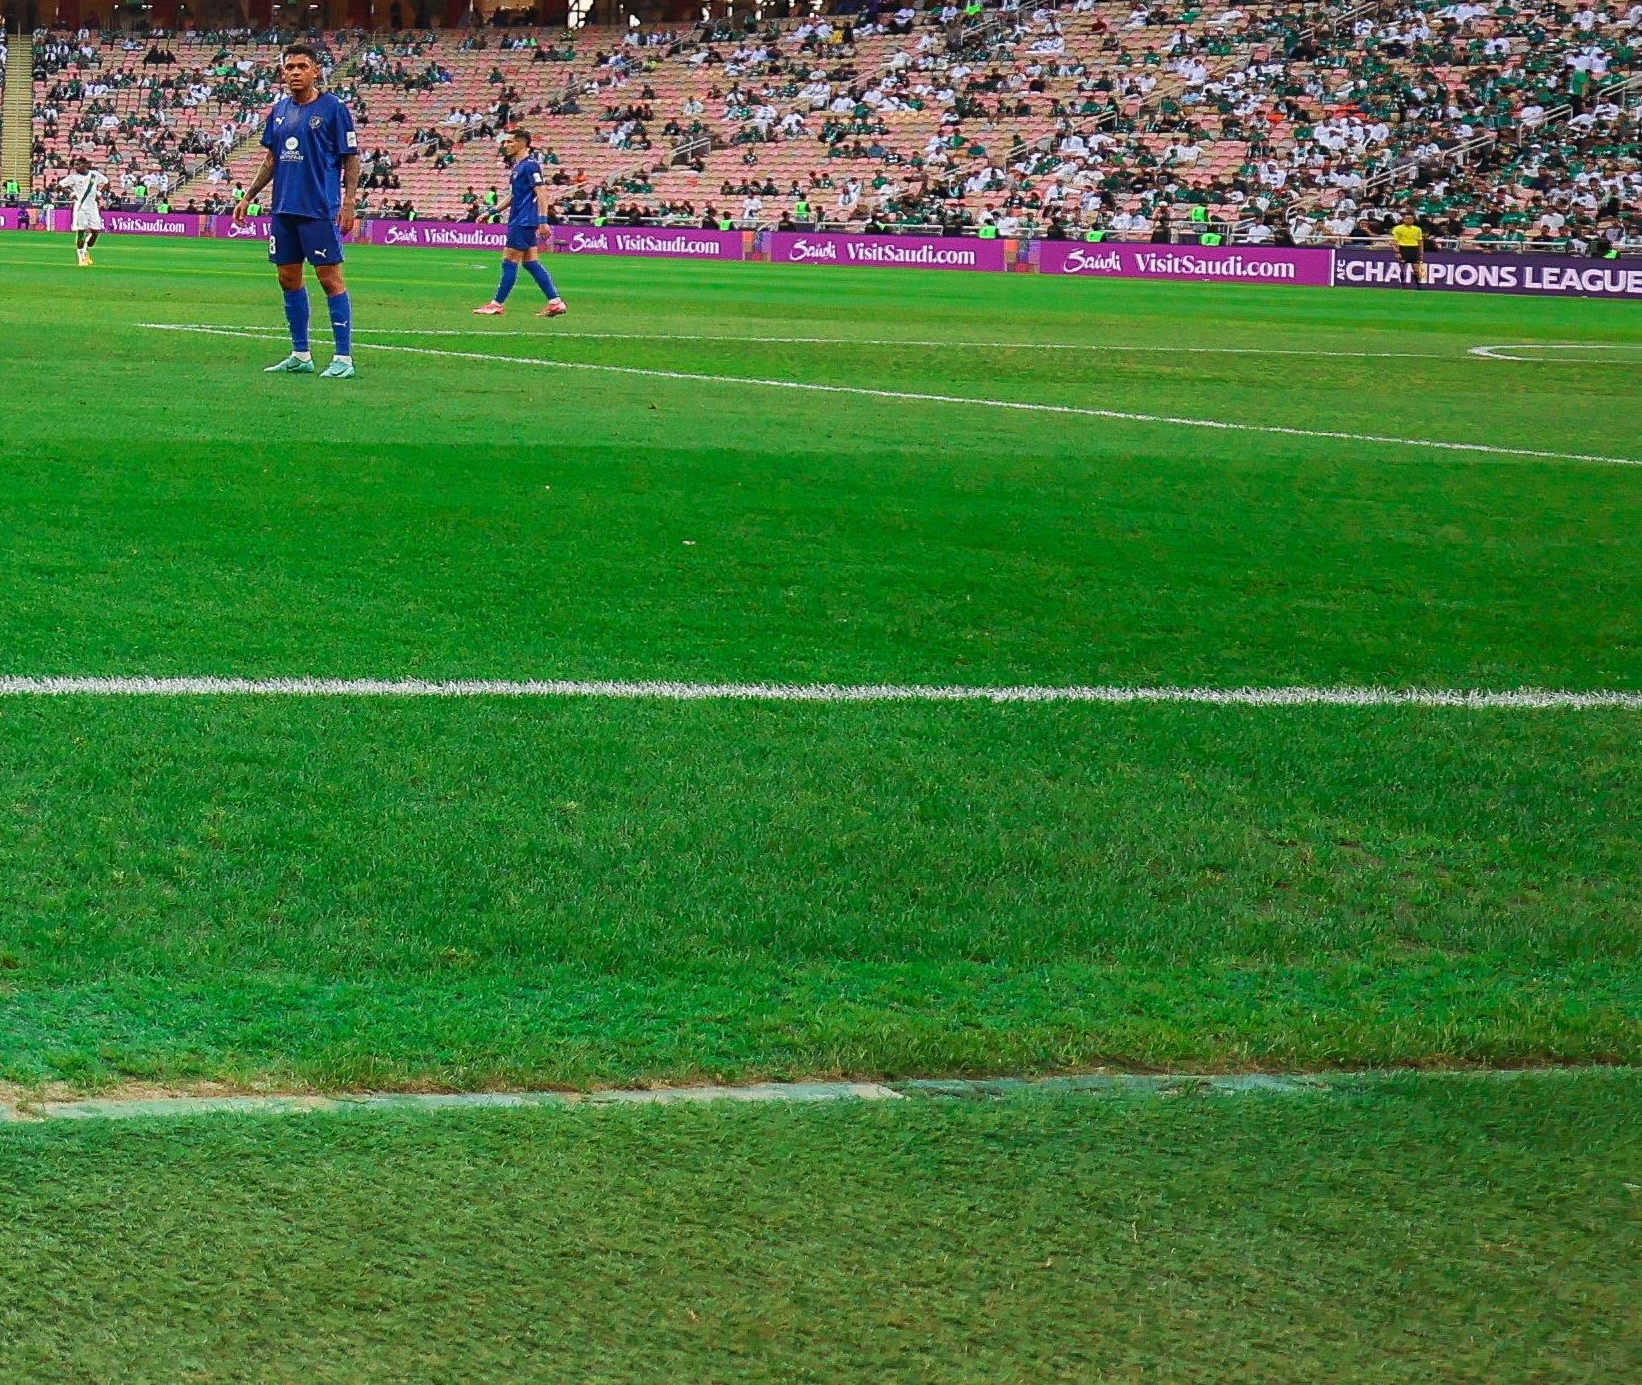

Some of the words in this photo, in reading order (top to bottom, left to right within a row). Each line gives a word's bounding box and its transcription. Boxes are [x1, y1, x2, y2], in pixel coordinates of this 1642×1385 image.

[111, 217, 185, 234] VisitSaudi.com
[385, 225, 417, 244] Saudi
[570, 231, 608, 252] Saudi
[616, 234, 720, 254] VisitSaudi.com
[789, 238, 836, 261] Saudi
[847, 242, 975, 265] VisitSaudi.com
[1064, 247, 1121, 273] Saudi
[1135, 252, 1295, 278] VisitSaudi.com
[1336, 259, 1346, 280] AFC
[1346, 260, 1517, 287] CHAMPIONS
[1524, 266, 1642, 293] LEAGUE
